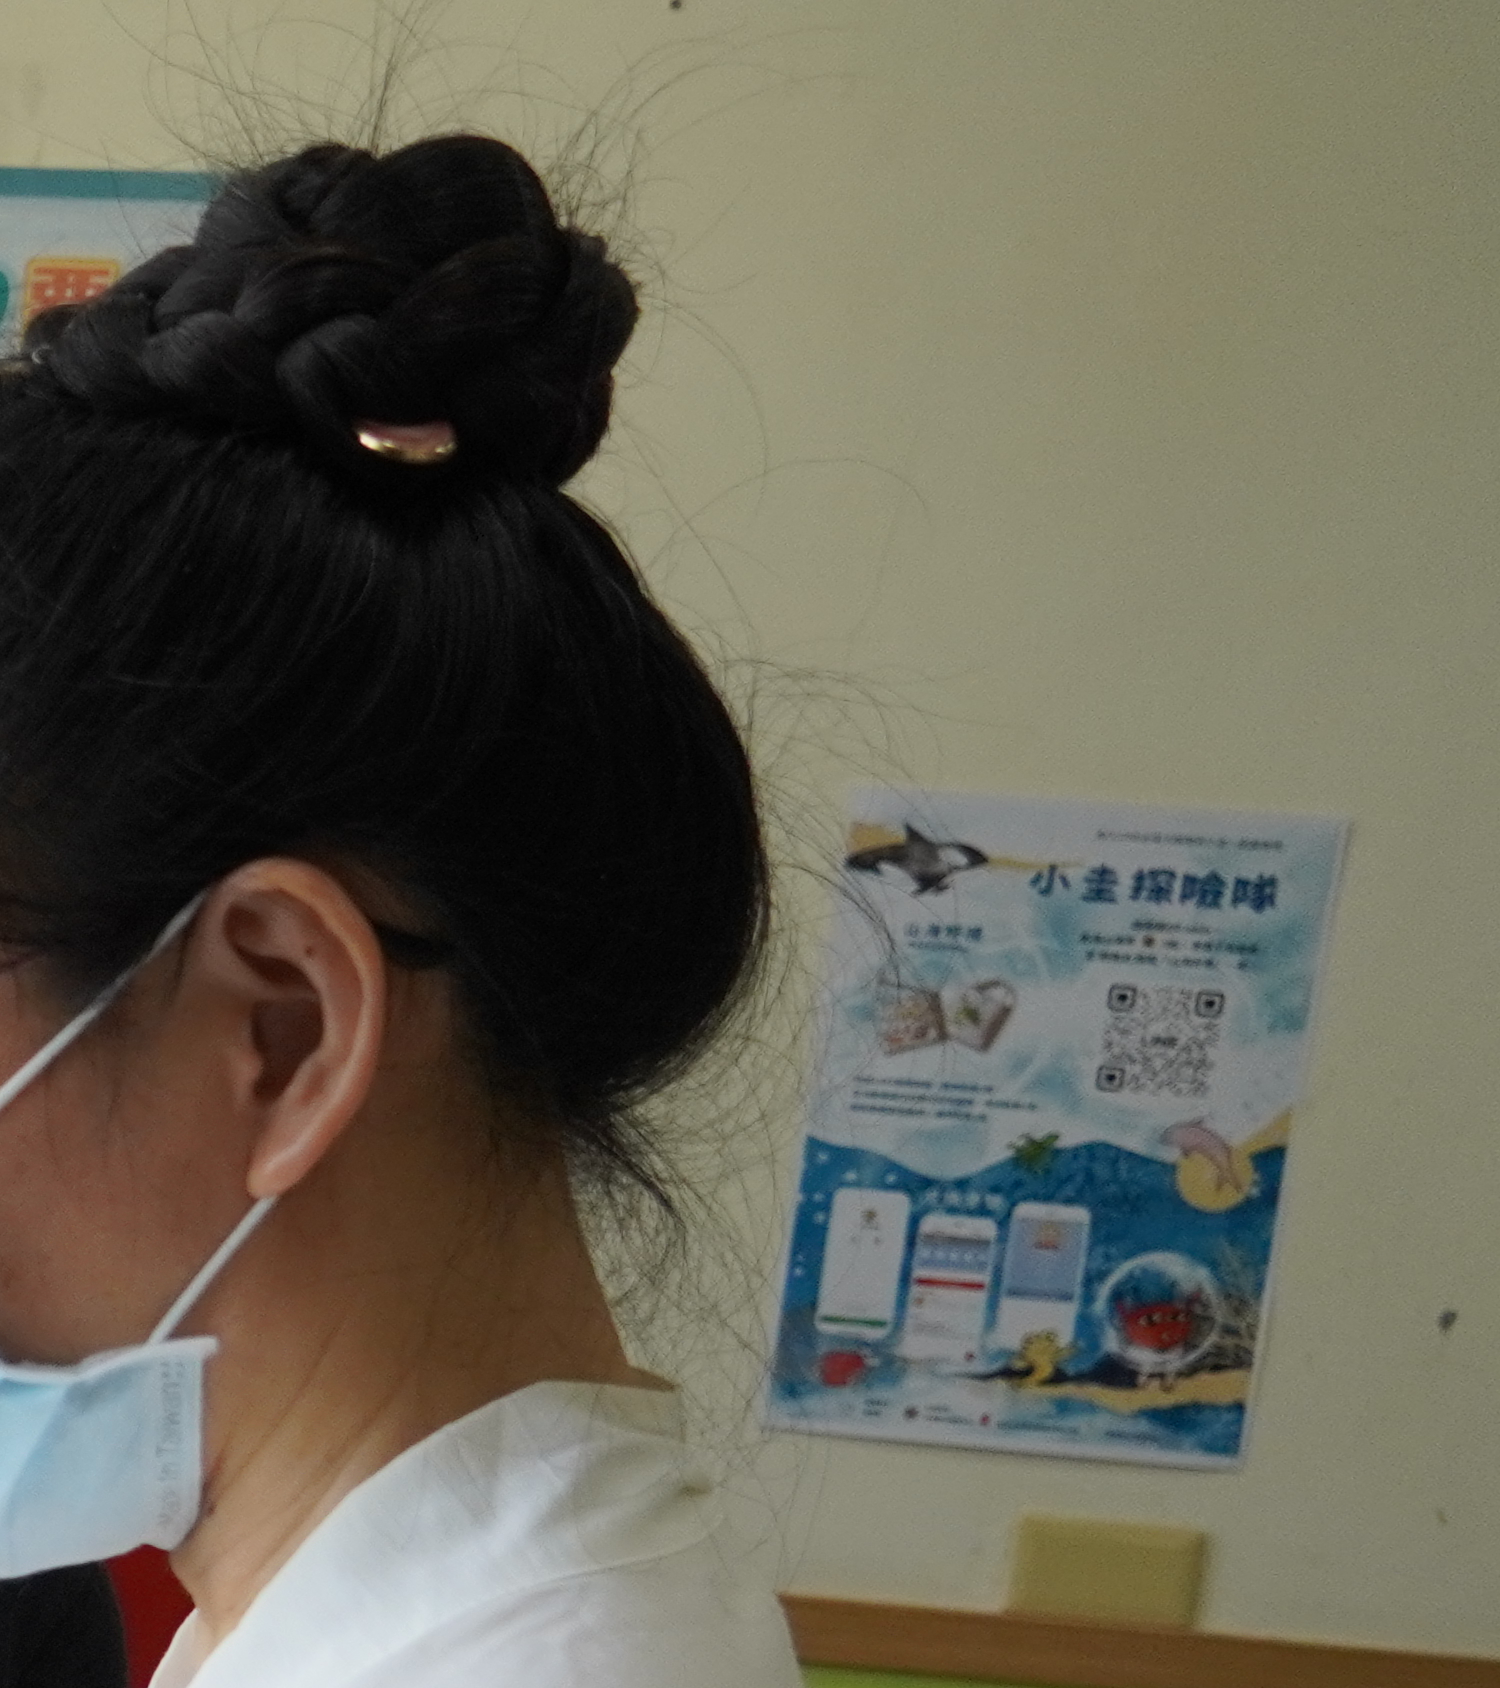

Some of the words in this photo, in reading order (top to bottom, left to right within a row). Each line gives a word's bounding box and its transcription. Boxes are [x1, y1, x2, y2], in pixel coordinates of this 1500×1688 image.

[1030, 863, 1278, 913] 小圭探險隊
